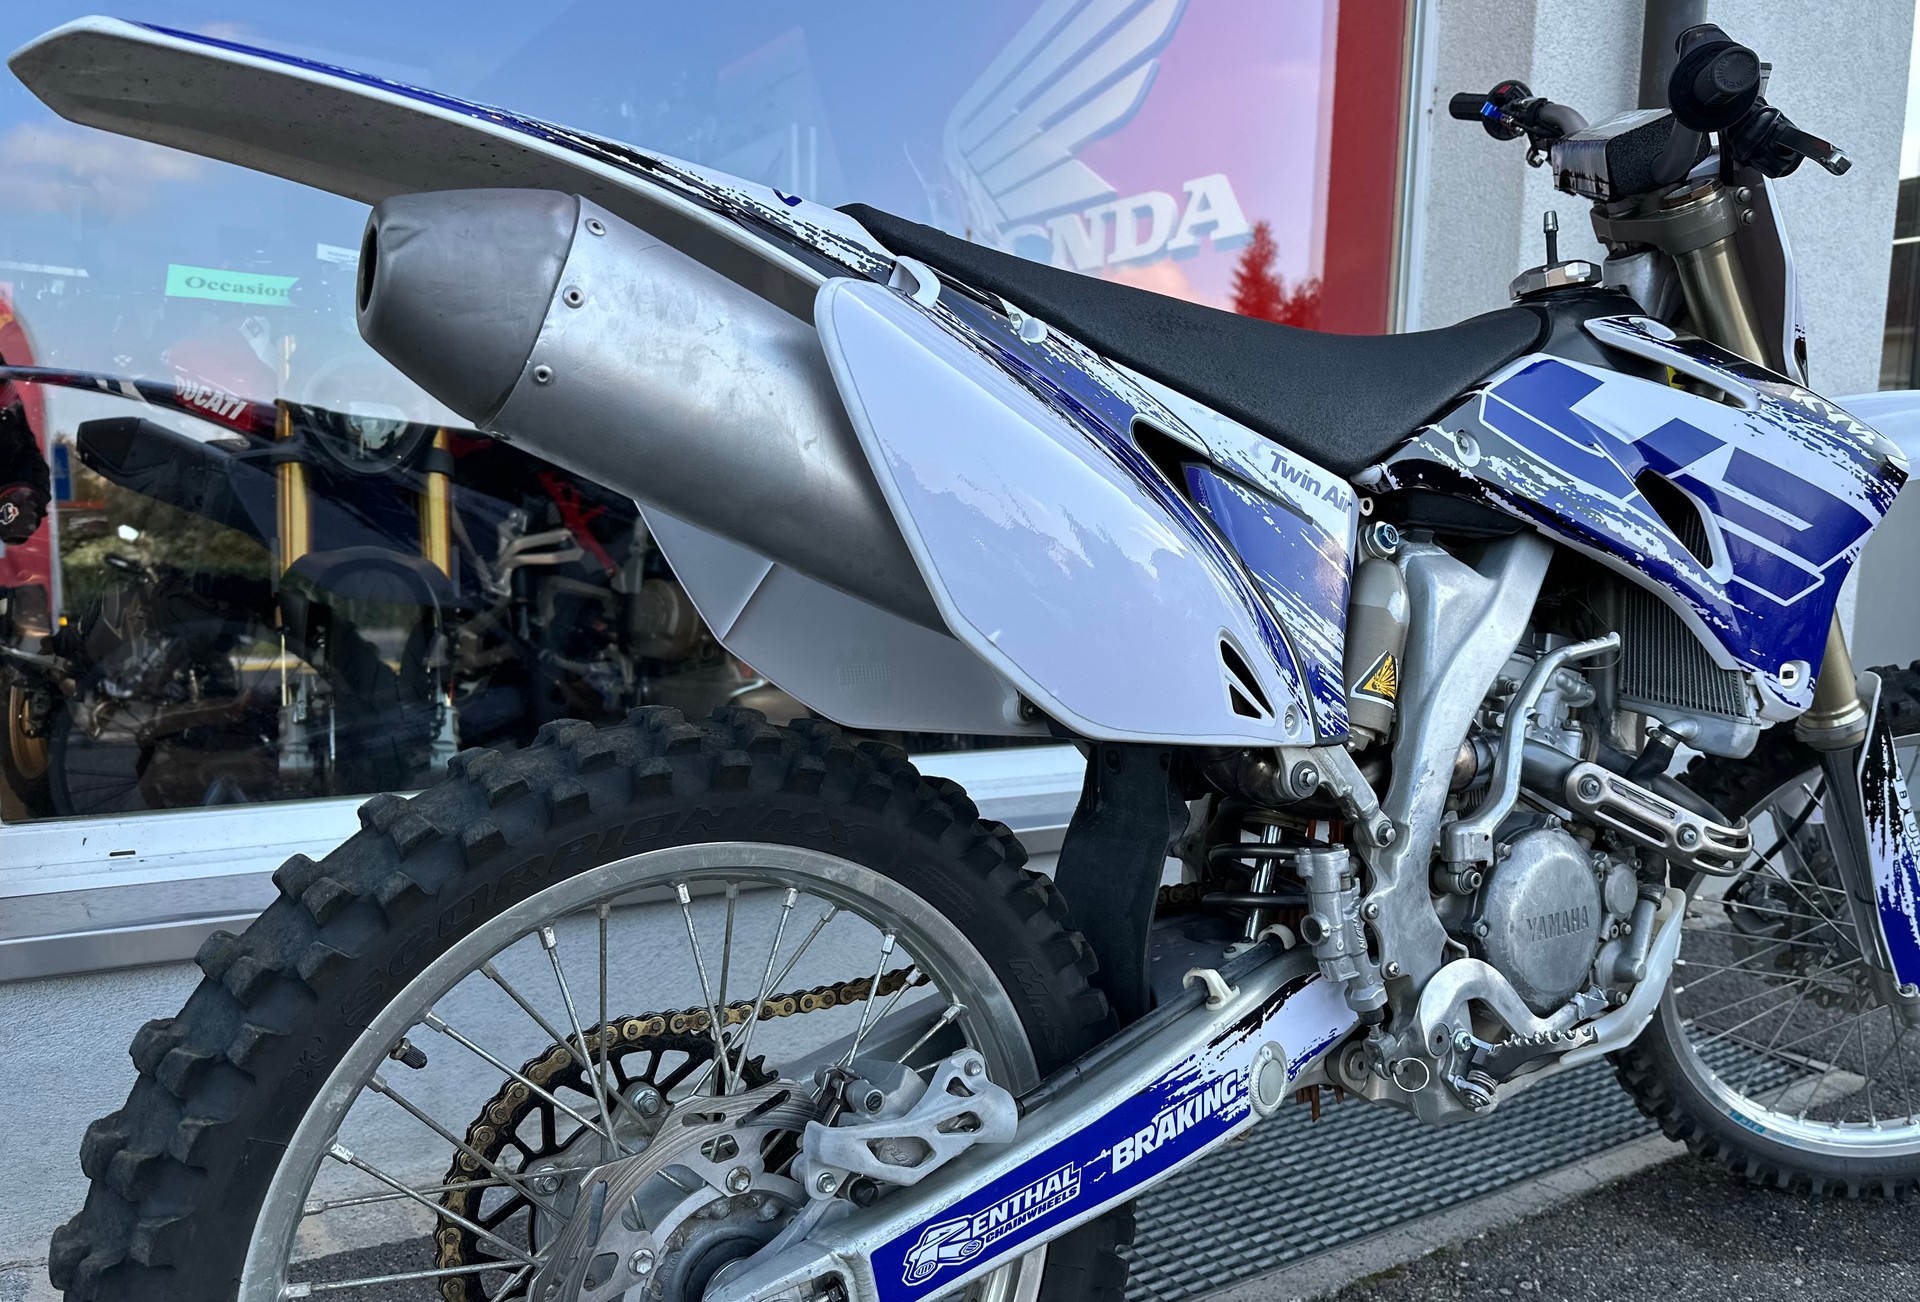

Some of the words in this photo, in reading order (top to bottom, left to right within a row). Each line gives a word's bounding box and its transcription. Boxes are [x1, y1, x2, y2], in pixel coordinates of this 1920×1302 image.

[185, 276, 288, 297] Occasion
[174, 375, 248, 421] DUCATI
[1270, 450, 1321, 496] Twin
[752, 808, 864, 844] MX
[1526, 905, 1589, 942] YAMAHA
[1112, 1071, 1238, 1175] BRAKING
[908, 1166, 1078, 1280] RENTHAL
[985, 1185, 1079, 1243] CHAINWHEELS
